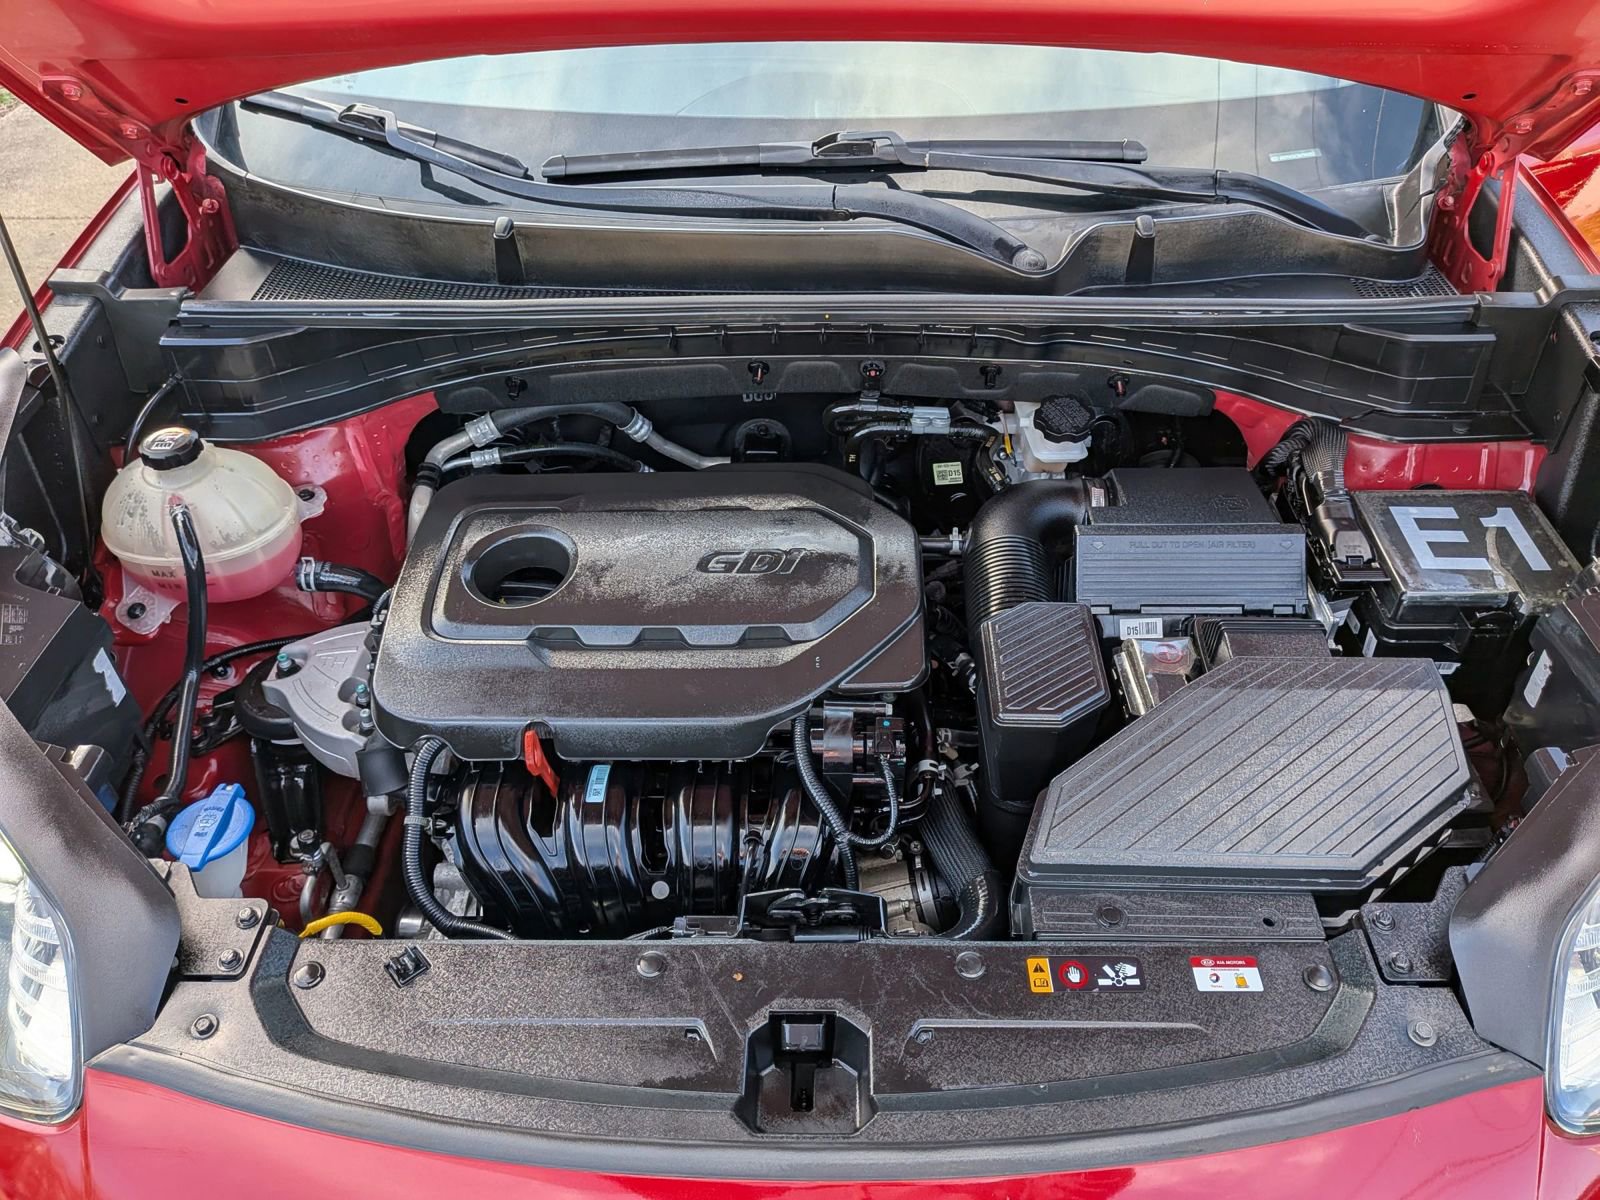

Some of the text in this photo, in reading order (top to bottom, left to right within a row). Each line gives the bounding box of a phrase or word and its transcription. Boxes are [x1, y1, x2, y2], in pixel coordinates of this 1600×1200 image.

[1388, 506, 1552, 570] E1
[151, 570, 176, 578] MAX
[1127, 626, 1138, 635] D15
